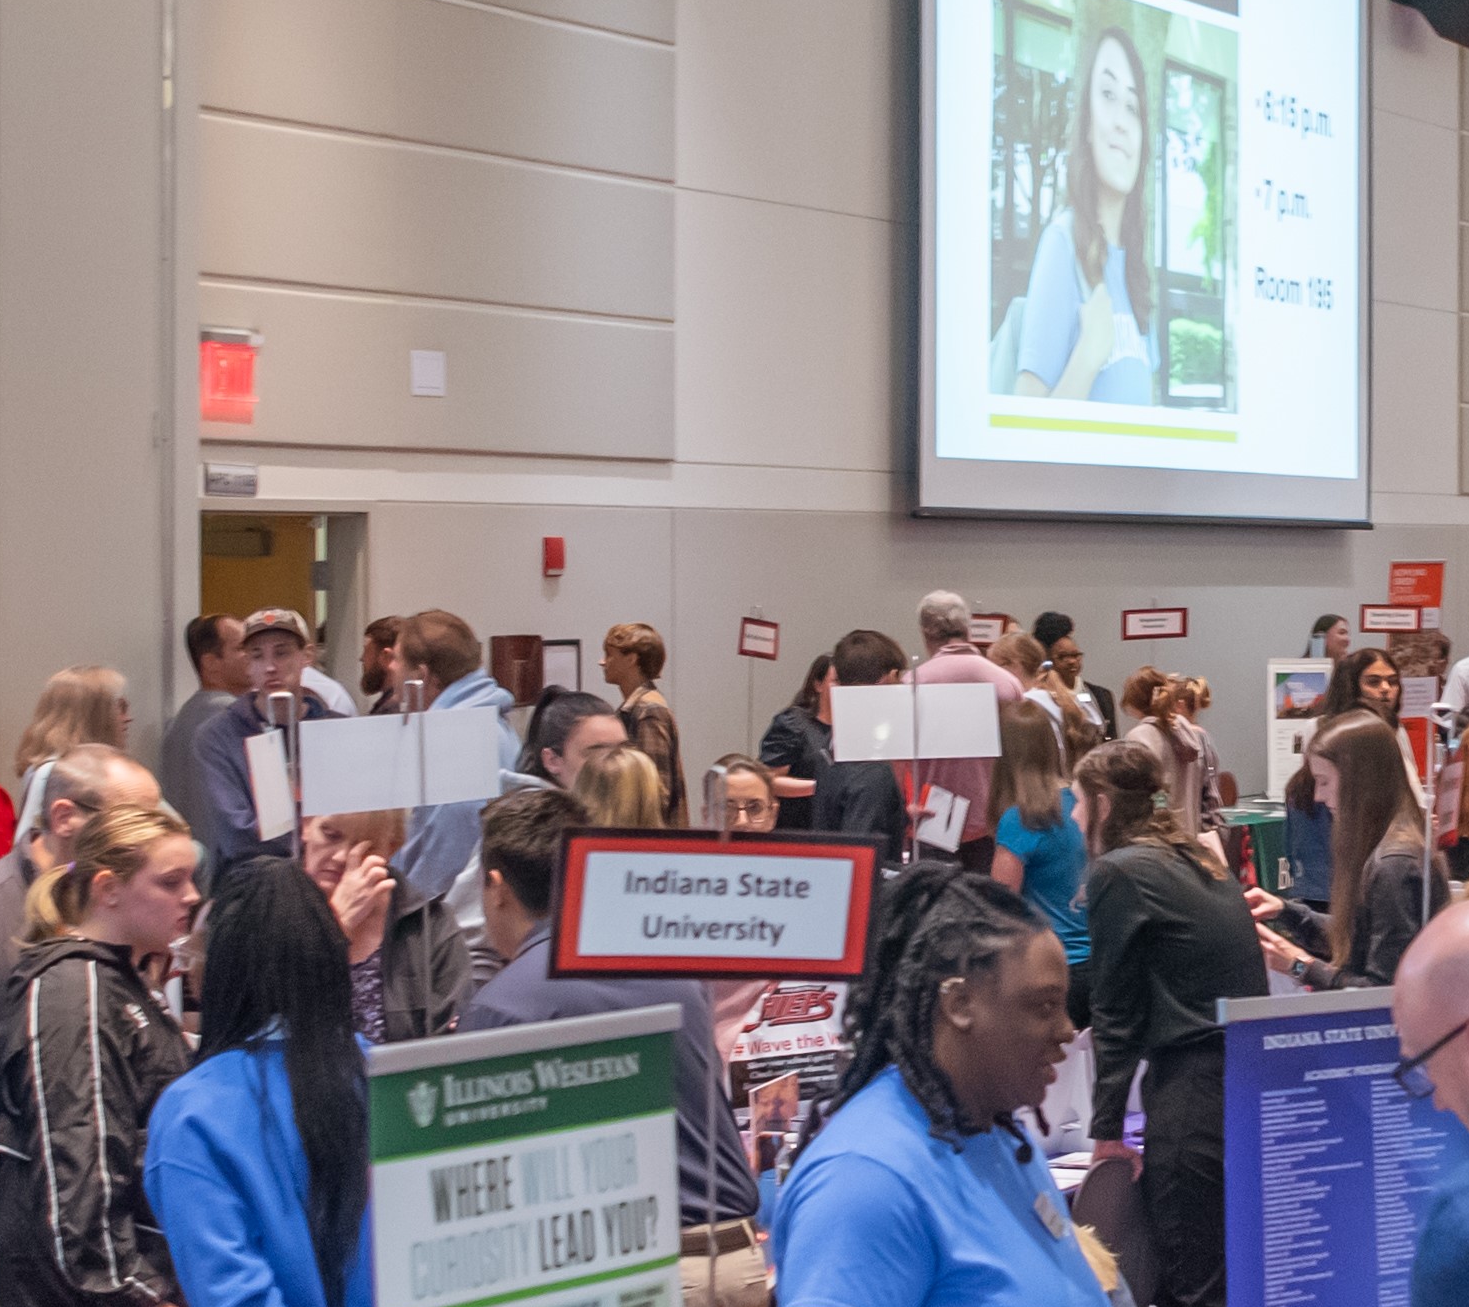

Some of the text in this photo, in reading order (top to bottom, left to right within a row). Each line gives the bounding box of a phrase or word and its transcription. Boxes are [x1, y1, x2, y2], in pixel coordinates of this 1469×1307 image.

[1254, 266, 1302, 305] Room
[624, 870, 811, 899] Indiana State
[642, 914, 786, 947] University
[534, 1052, 640, 1090] WESLEYAN
[430, 1154, 514, 1224] WHERE
[537, 1207, 597, 1272] LEAD
[601, 1195, 659, 1257] YOU?
